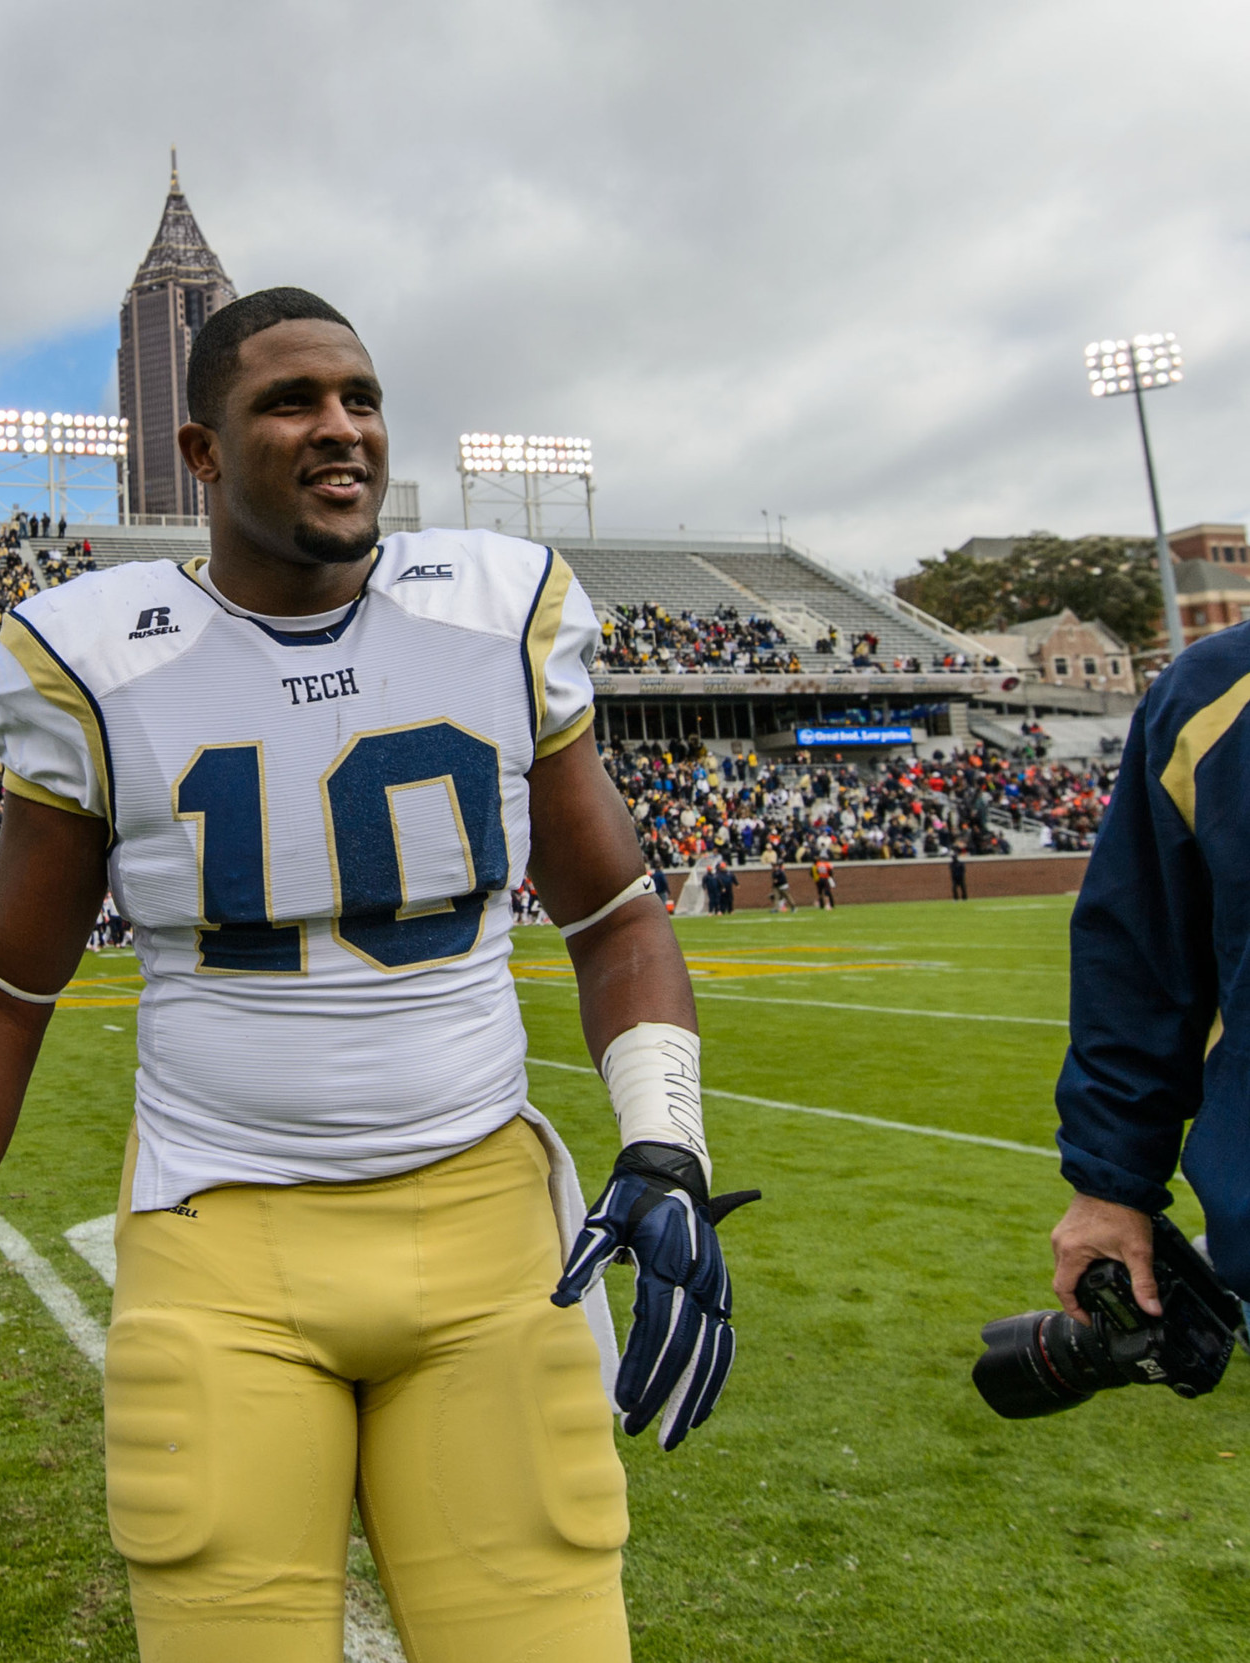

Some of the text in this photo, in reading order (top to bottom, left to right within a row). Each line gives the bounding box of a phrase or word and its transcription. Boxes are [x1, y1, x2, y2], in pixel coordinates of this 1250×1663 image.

[401, 564, 453, 578] ACC
[128, 624, 181, 640] RUSSELL
[282, 667, 359, 704] TECH
[815, 731, 839, 741] Great
[840, 731, 860, 741] food.
[861, 730, 880, 741] Low
[171, 716, 512, 977] 10
